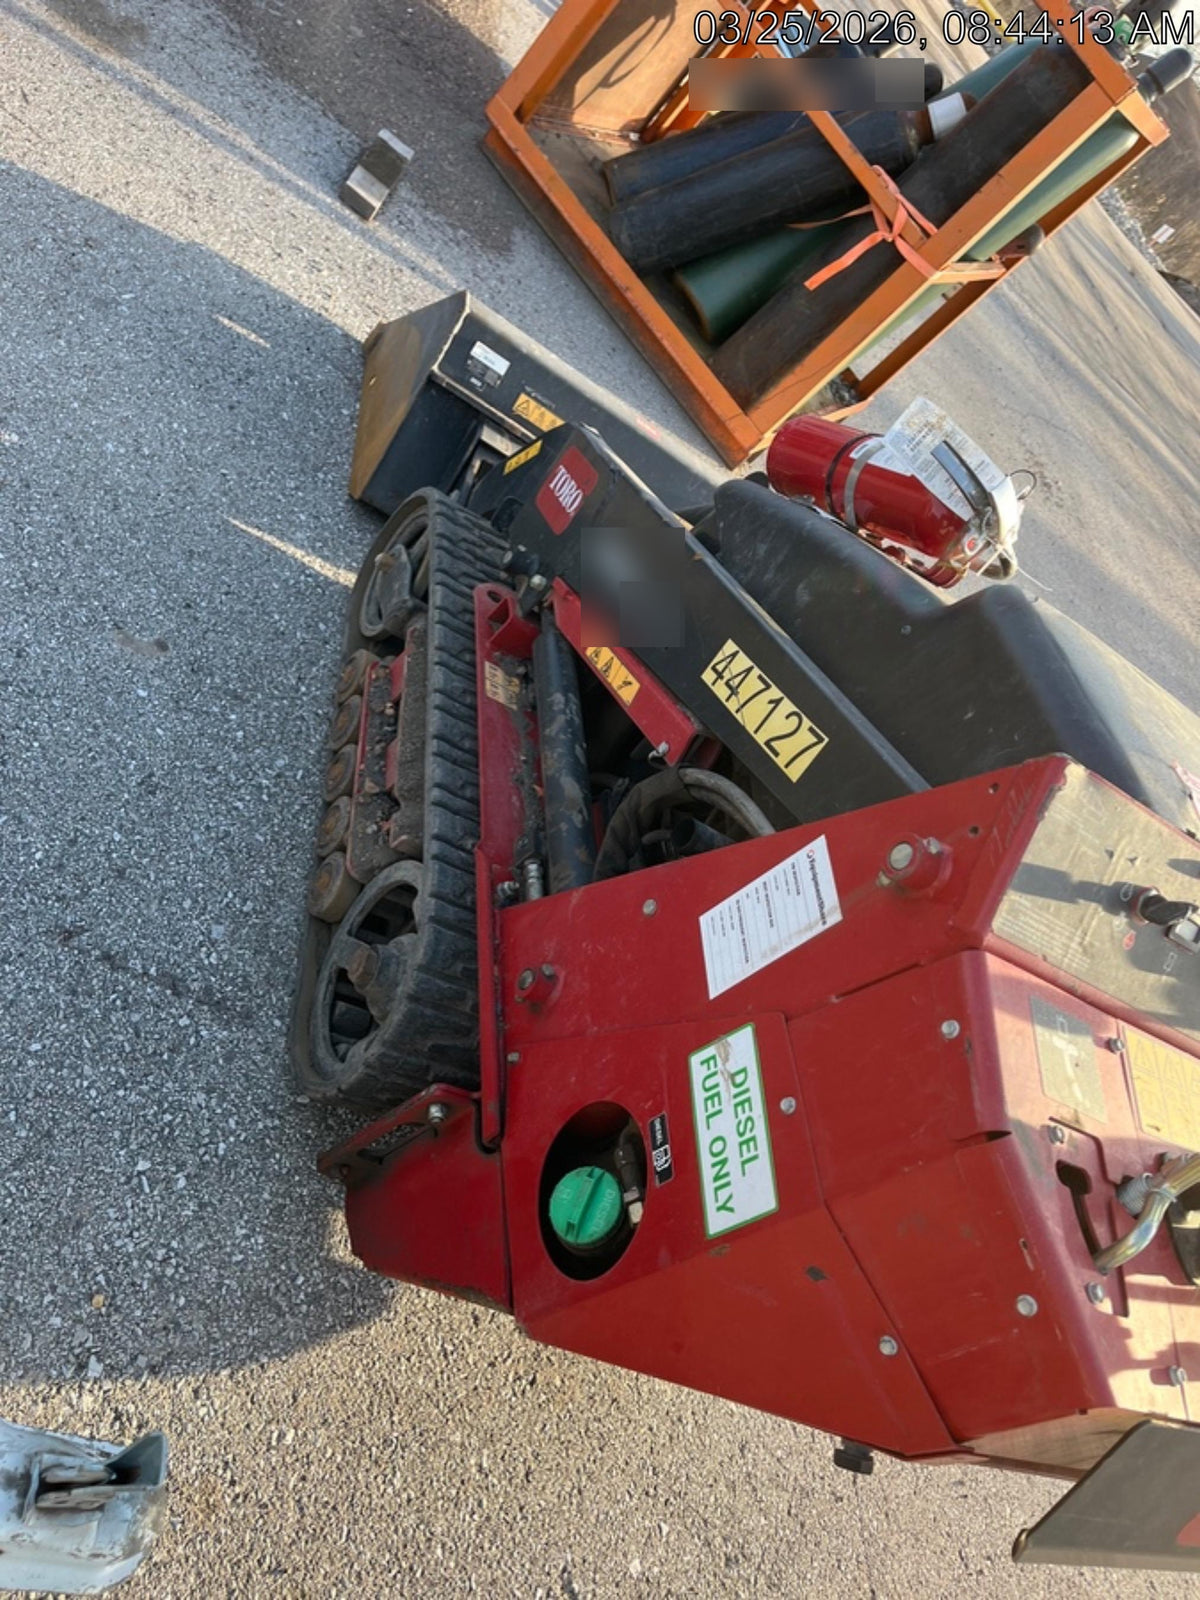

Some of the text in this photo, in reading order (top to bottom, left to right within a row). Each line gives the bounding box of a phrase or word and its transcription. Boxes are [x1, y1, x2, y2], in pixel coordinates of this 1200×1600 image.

[549, 465, 582, 513] TORO
[710, 649, 826, 769] 447127
[700, 1054, 735, 1215] FUEL ONLY
[730, 1067, 760, 1177] DIESEL
